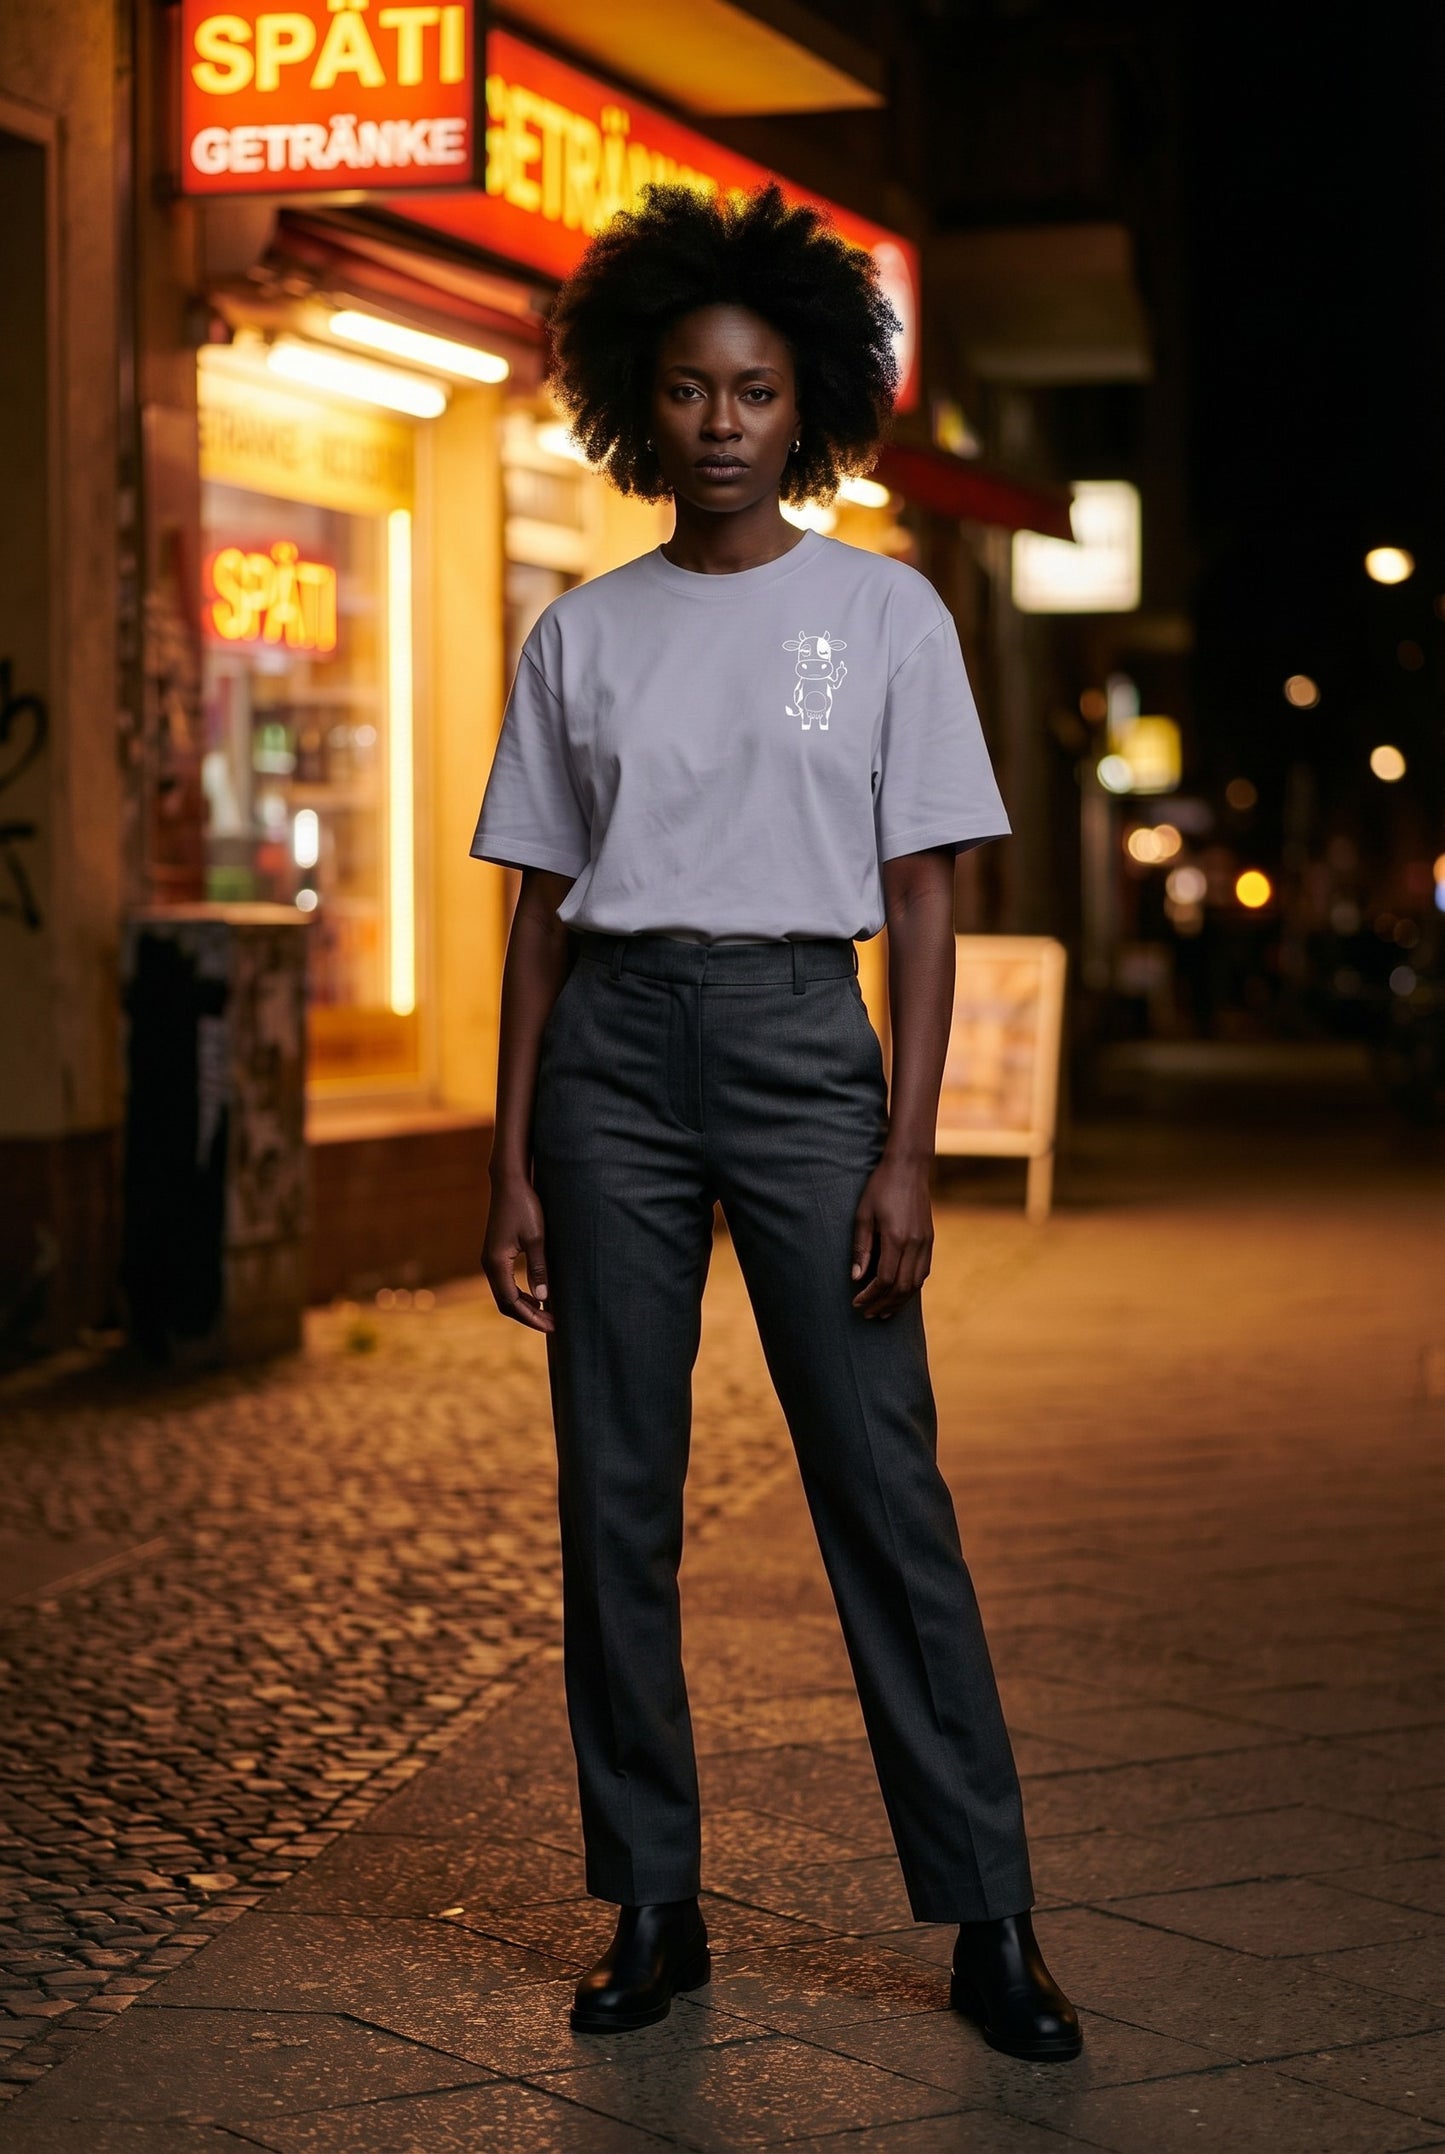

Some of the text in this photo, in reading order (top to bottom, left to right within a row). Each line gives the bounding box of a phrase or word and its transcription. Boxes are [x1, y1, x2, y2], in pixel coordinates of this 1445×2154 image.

[191, 0, 465, 95] SPÄTI
[191, 114, 467, 175] GETRÄNKE
[212, 541, 336, 652] SPÄTI
